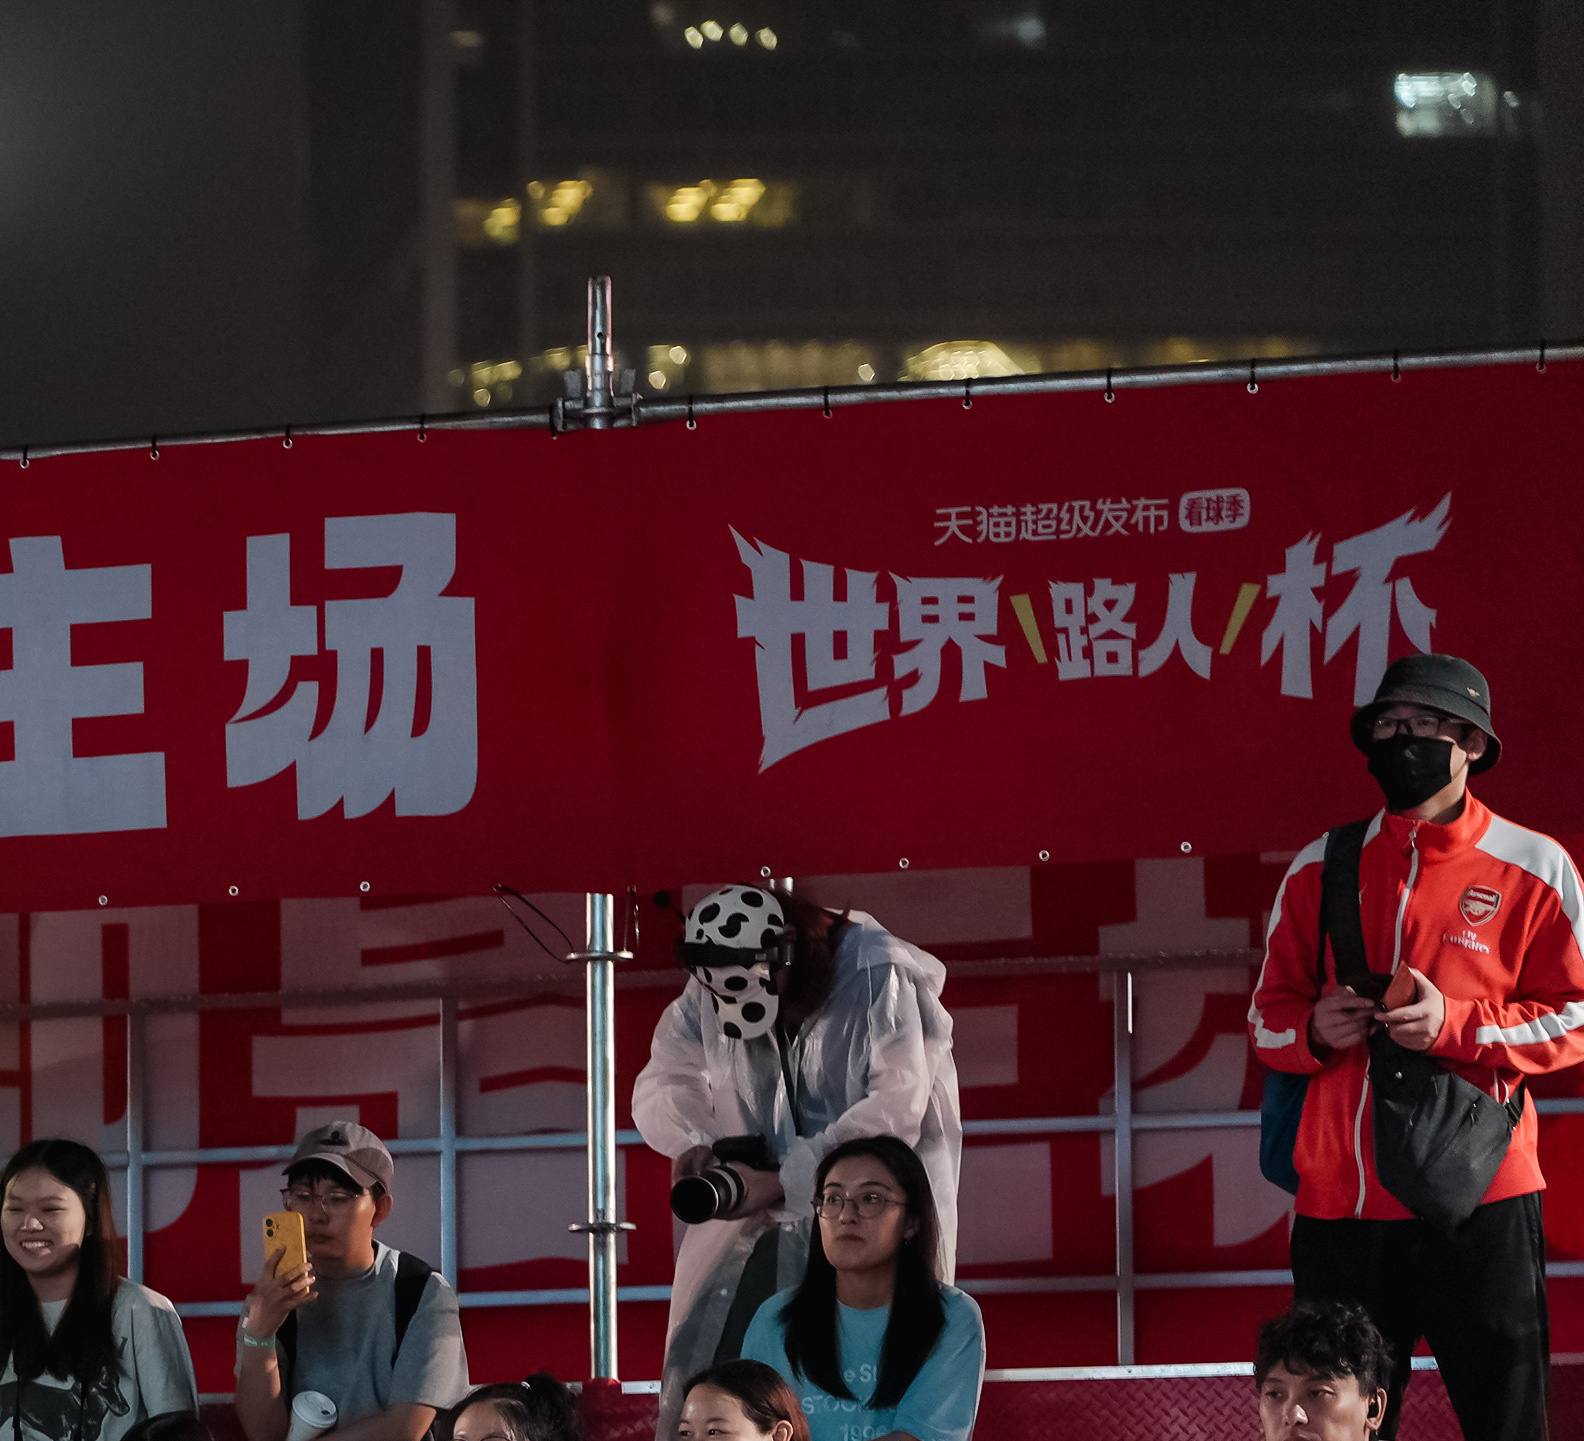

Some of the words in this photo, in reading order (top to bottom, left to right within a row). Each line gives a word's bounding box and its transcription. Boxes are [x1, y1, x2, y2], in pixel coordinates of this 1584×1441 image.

[934, 497, 1169, 546] 天猫超级发布
[1184, 494, 1242, 528] 看球季
[729, 524, 1006, 772] 世界
[1048, 572, 1212, 682] 路人
[1261, 491, 1453, 708] 杯
